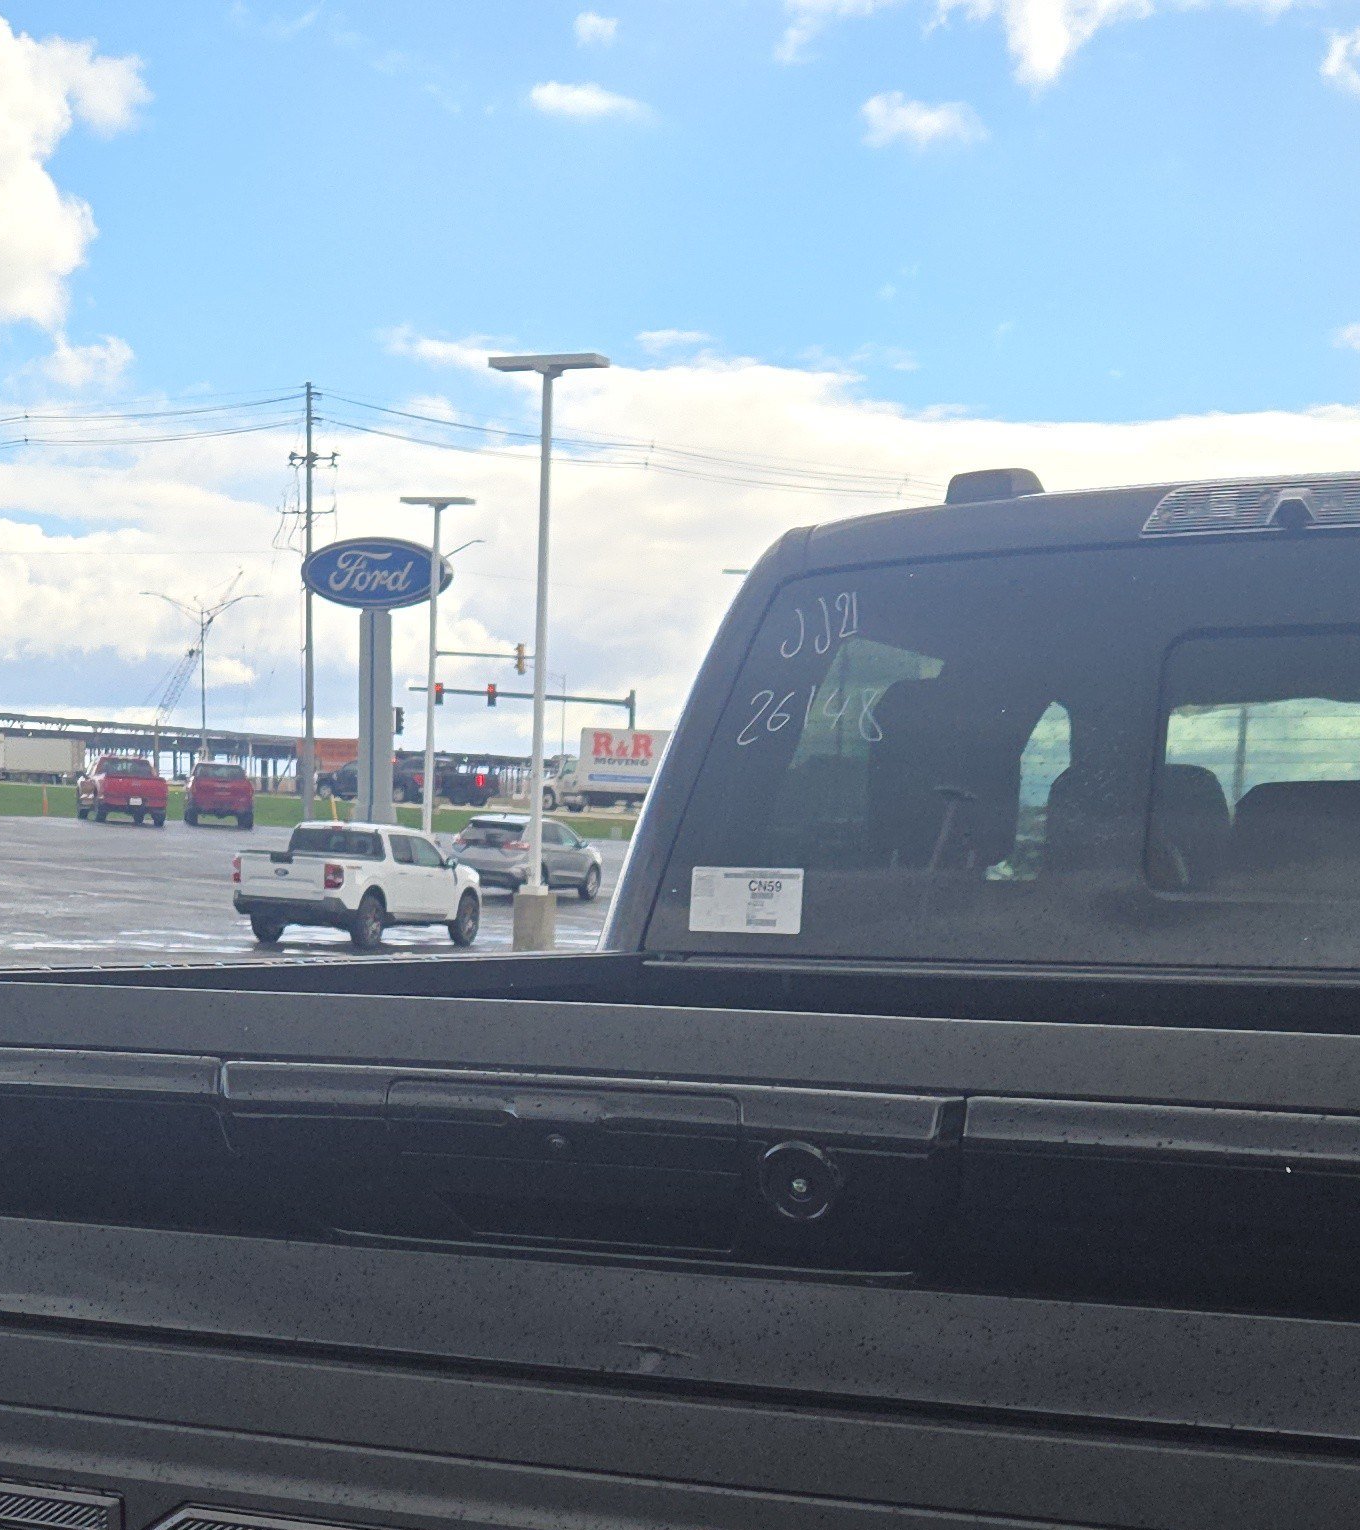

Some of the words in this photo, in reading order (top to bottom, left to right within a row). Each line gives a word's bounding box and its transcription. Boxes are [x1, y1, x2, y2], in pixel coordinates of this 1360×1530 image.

[328, 551, 414, 592] Ford
[737, 685, 883, 745] 26148
[748, 880, 782, 893] CN59
